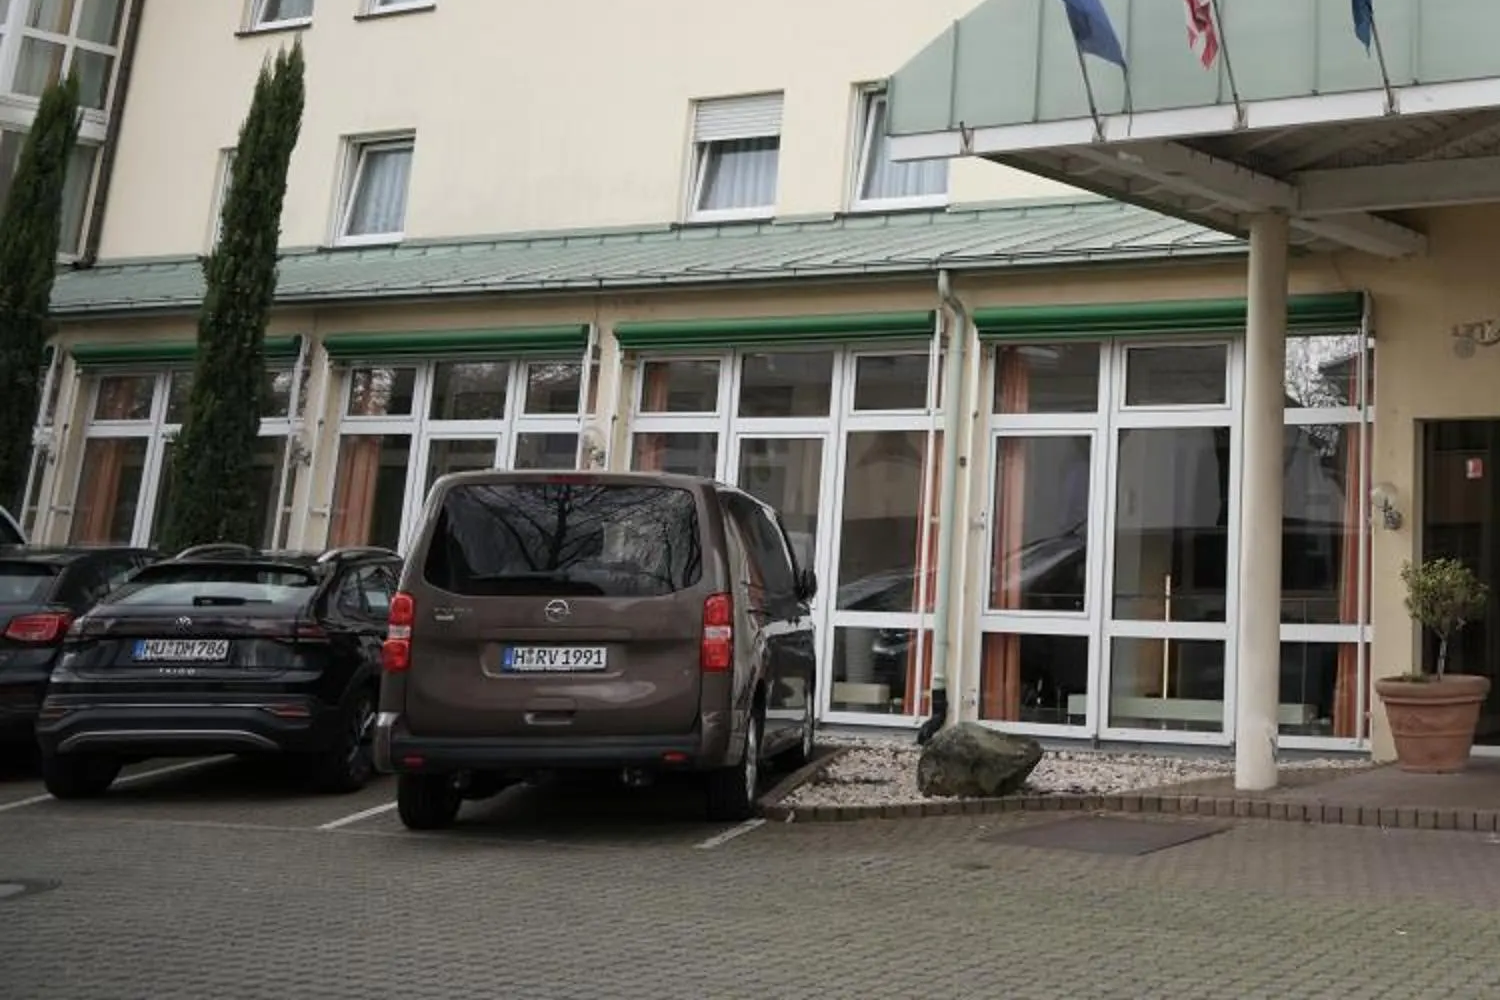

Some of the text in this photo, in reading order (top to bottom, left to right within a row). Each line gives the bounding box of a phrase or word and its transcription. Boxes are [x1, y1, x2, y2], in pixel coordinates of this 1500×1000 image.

[198, 642, 225, 655] 786
[513, 649, 603, 665] H RV 1991
